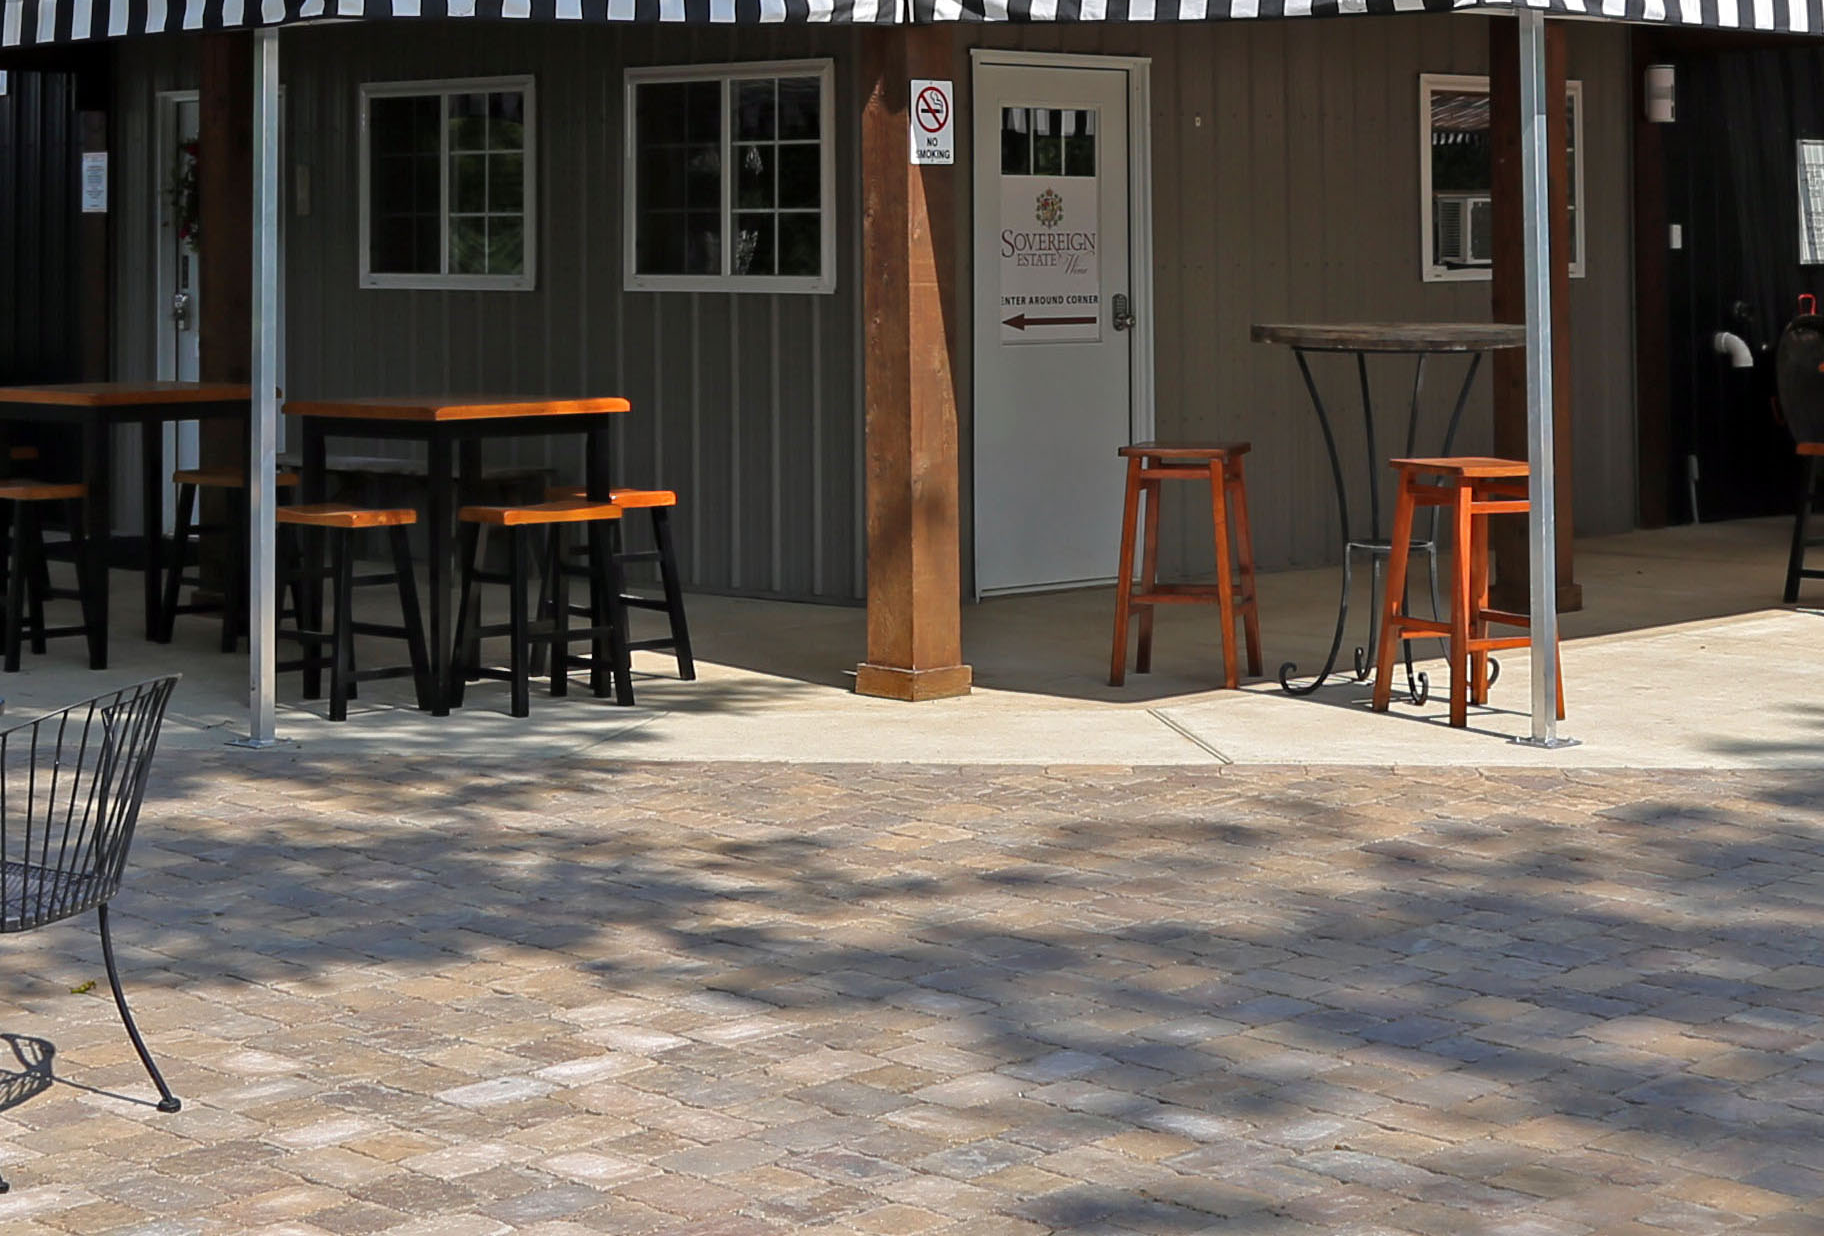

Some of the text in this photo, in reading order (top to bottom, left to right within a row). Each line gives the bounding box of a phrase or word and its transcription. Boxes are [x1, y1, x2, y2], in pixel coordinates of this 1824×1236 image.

[926, 137, 938, 147] NO
[916, 149, 951, 159] SMOKING
[1017, 253, 1057, 267] ESTATE
[1001, 295, 1099, 305] ENTER AROUND CORNER
